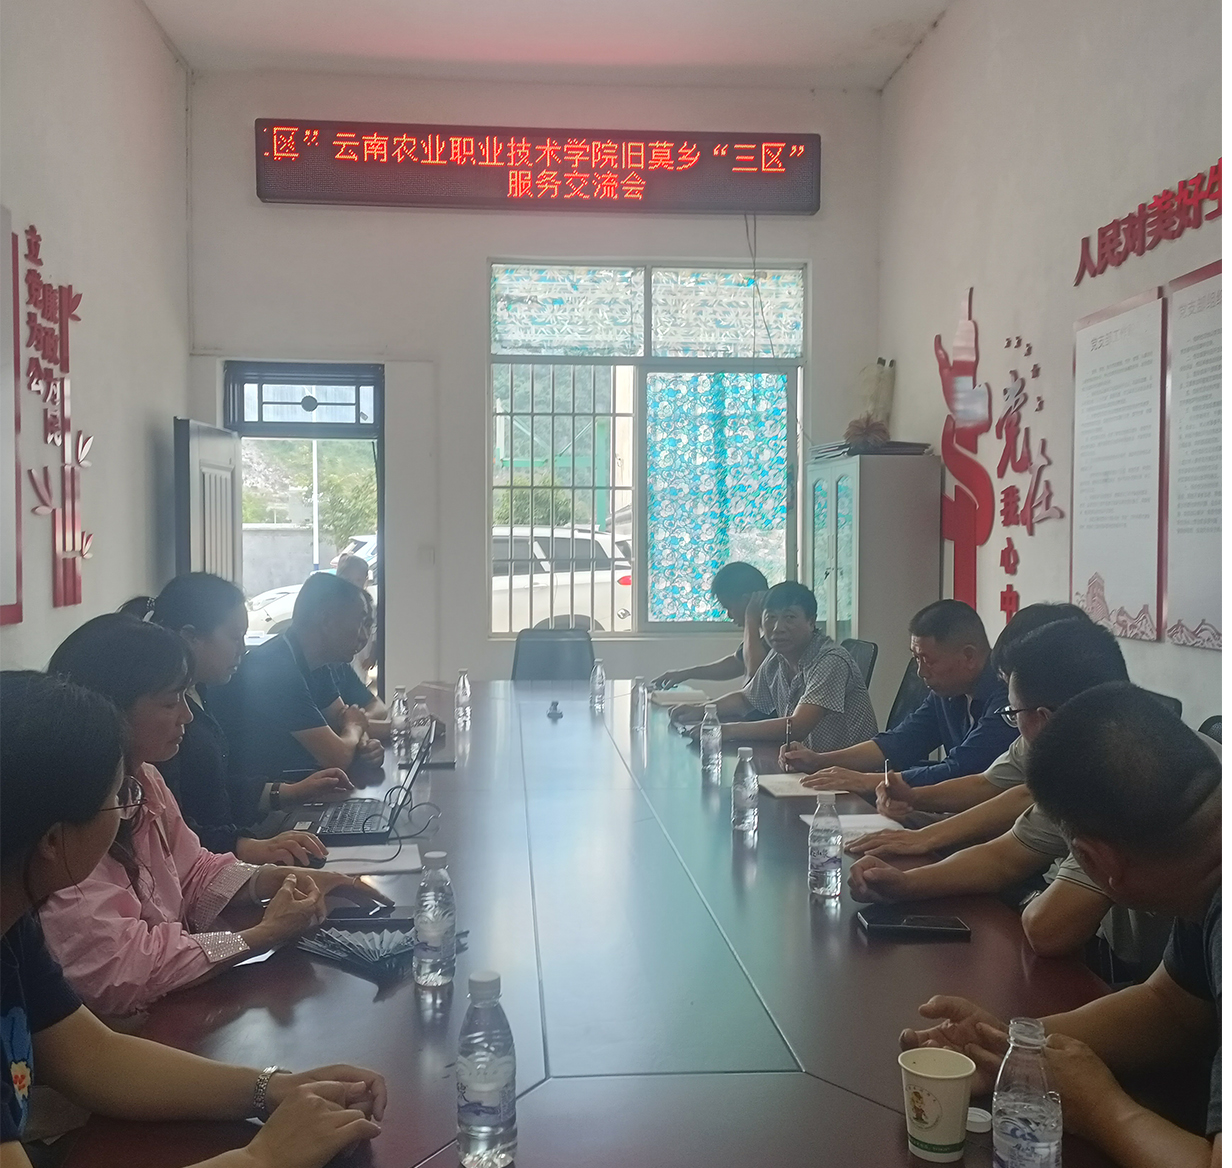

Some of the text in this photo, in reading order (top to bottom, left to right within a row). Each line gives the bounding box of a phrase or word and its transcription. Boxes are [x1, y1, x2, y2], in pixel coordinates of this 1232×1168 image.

[507, 169, 646, 200] 服务交流会
